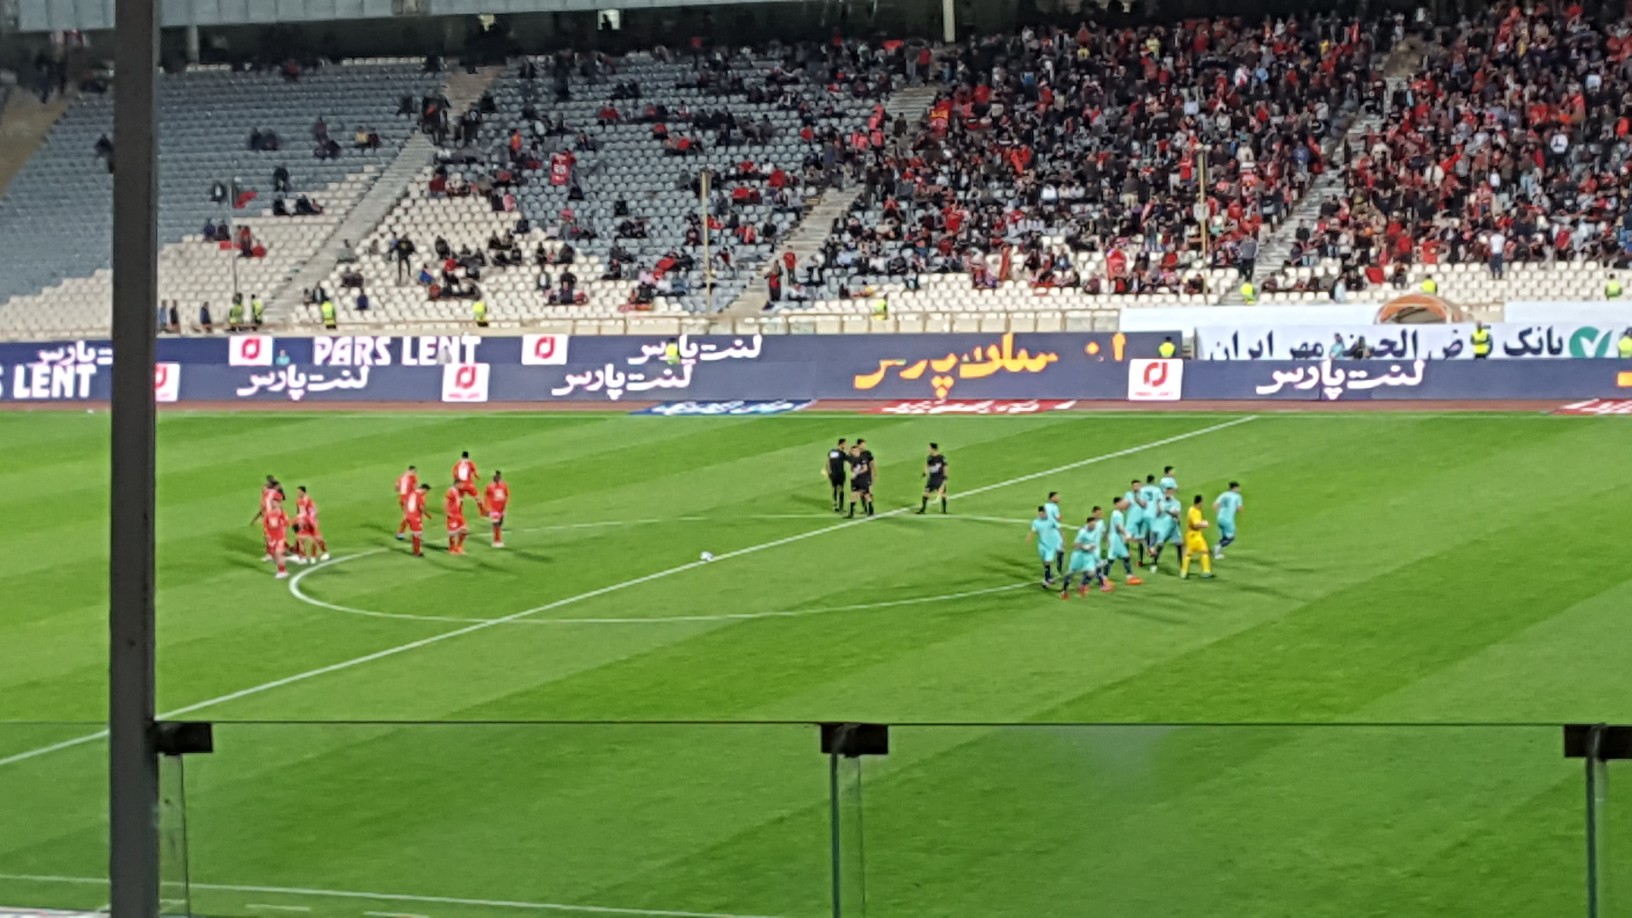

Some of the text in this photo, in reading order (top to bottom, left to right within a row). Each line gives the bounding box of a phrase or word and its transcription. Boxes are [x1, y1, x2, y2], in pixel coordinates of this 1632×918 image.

[314, 335, 482, 366] PARS LENT
[13, 364, 97, 399] LENT
[236, 364, 370, 401] لنت پارس
[551, 363, 693, 400] لنت پارس
[1255, 358, 1426, 400] لنت پارس
